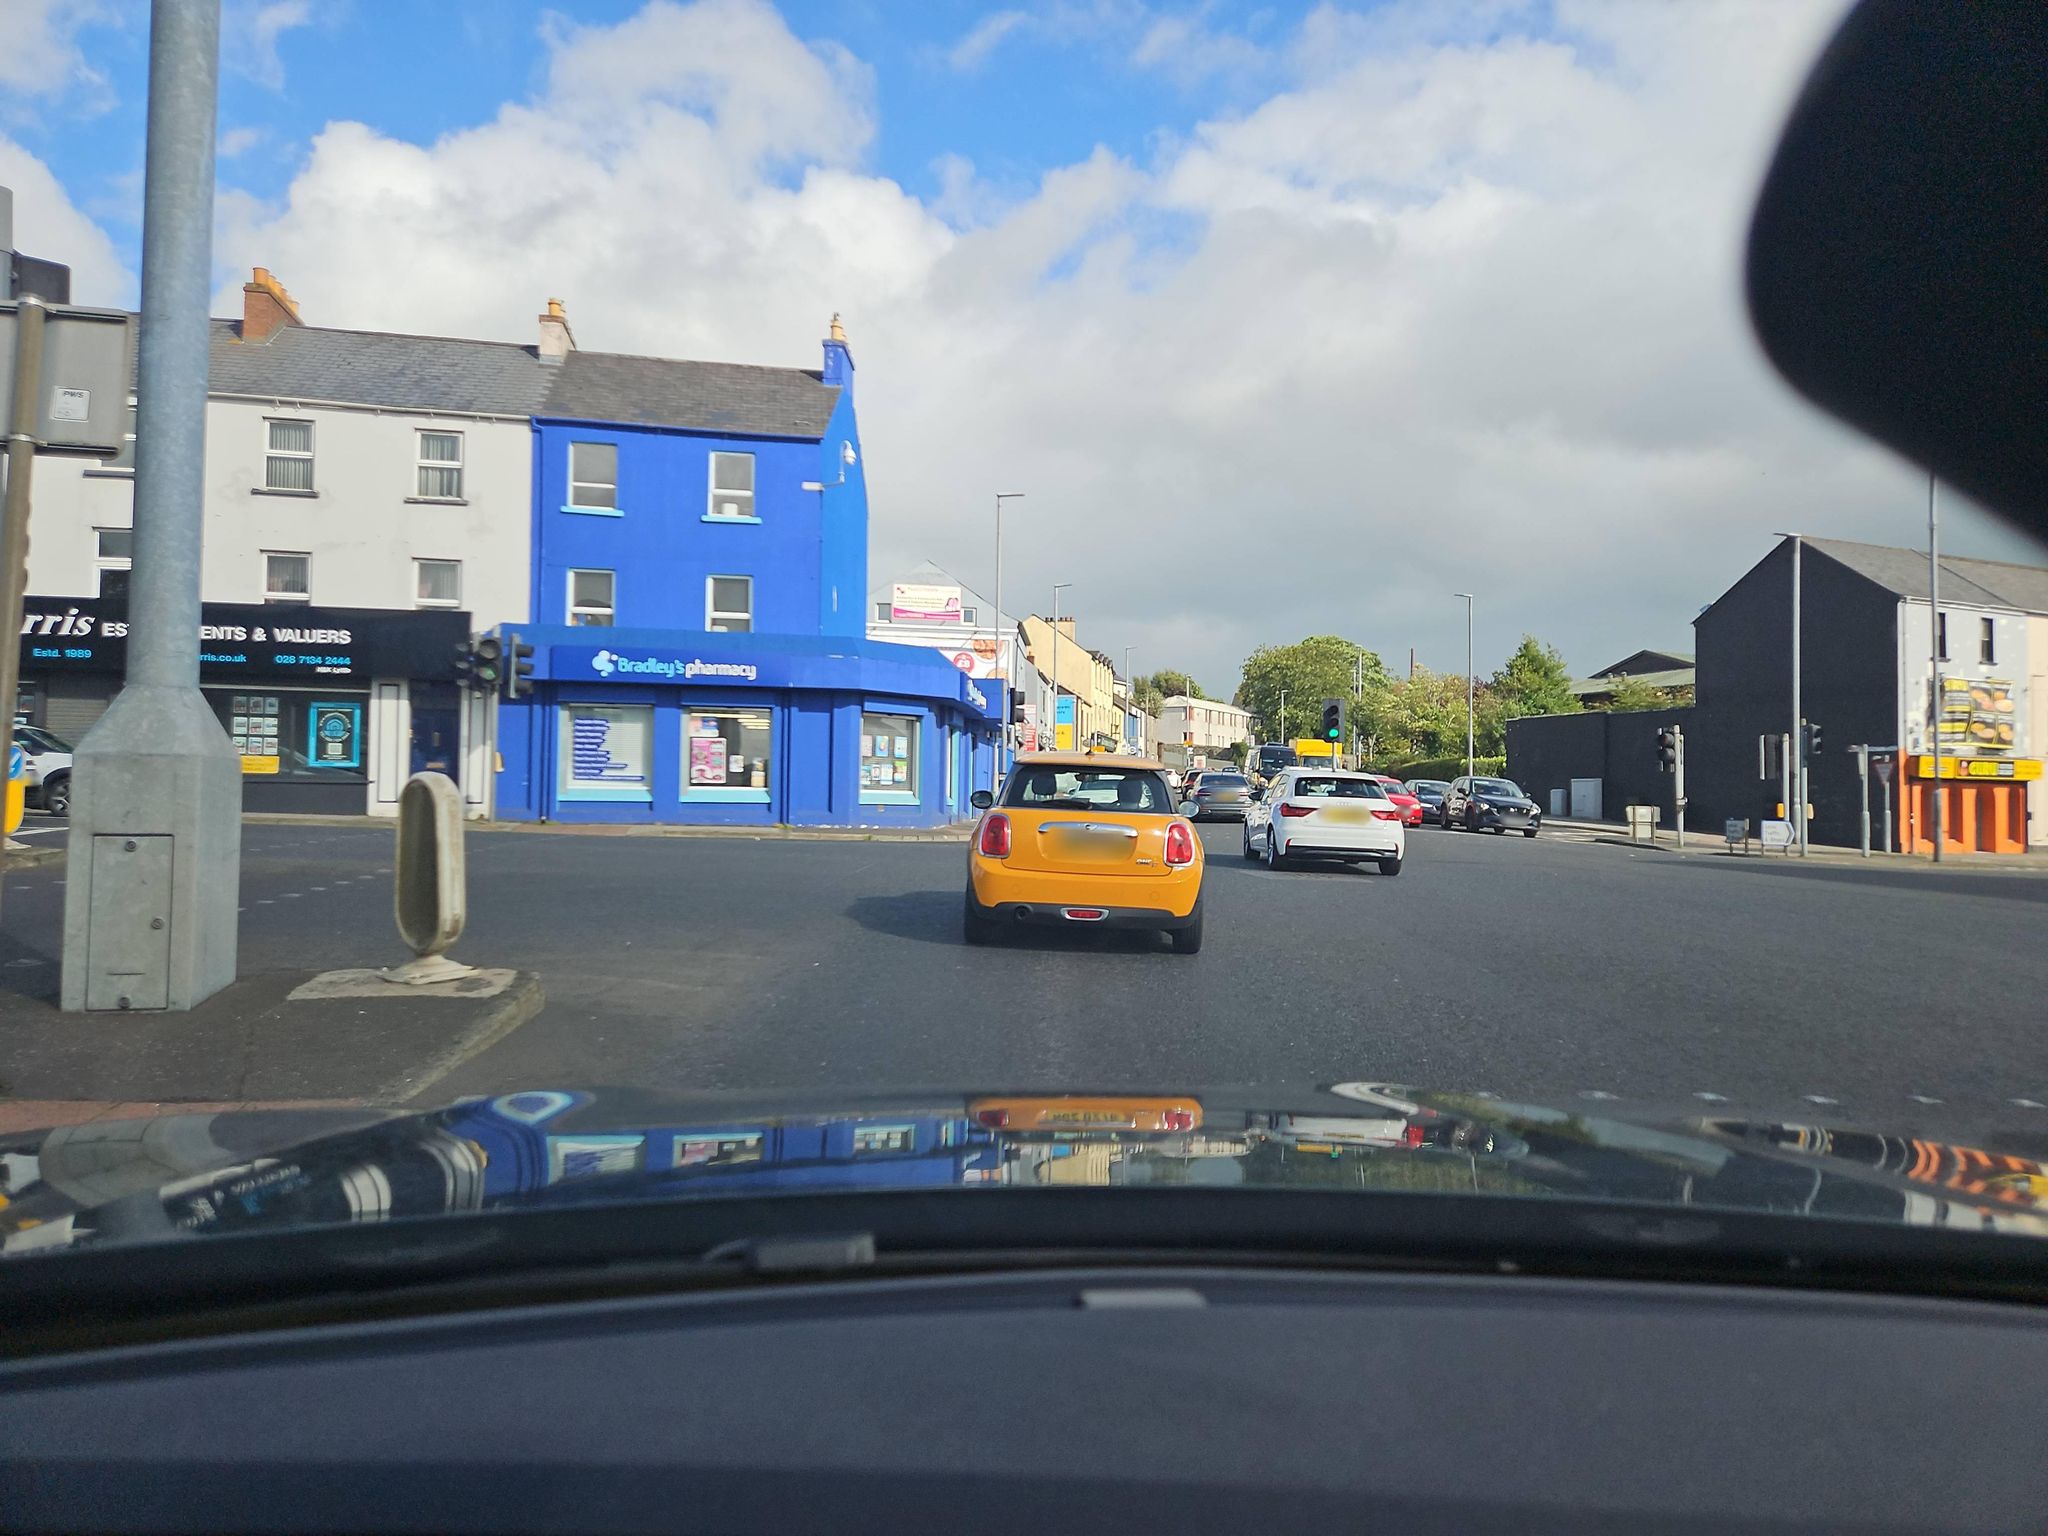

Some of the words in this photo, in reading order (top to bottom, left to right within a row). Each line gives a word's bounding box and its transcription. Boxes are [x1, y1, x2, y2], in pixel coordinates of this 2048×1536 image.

[20, 608, 96, 636] rris
[200, 625, 248, 641] ENTS
[252, 627, 267, 642] &
[273, 627, 352, 644] VALUERS
[32, 648, 62, 658] Estd.
[65, 649, 92, 659] 1989
[198, 652, 247, 663] rris.co.uk
[274, 654, 296, 664] 028
[299, 655, 323, 665] 7134
[325, 656, 352, 666] 2444
[617, 656, 685, 678] Bradley's
[685, 658, 757, 681] pharmacy
